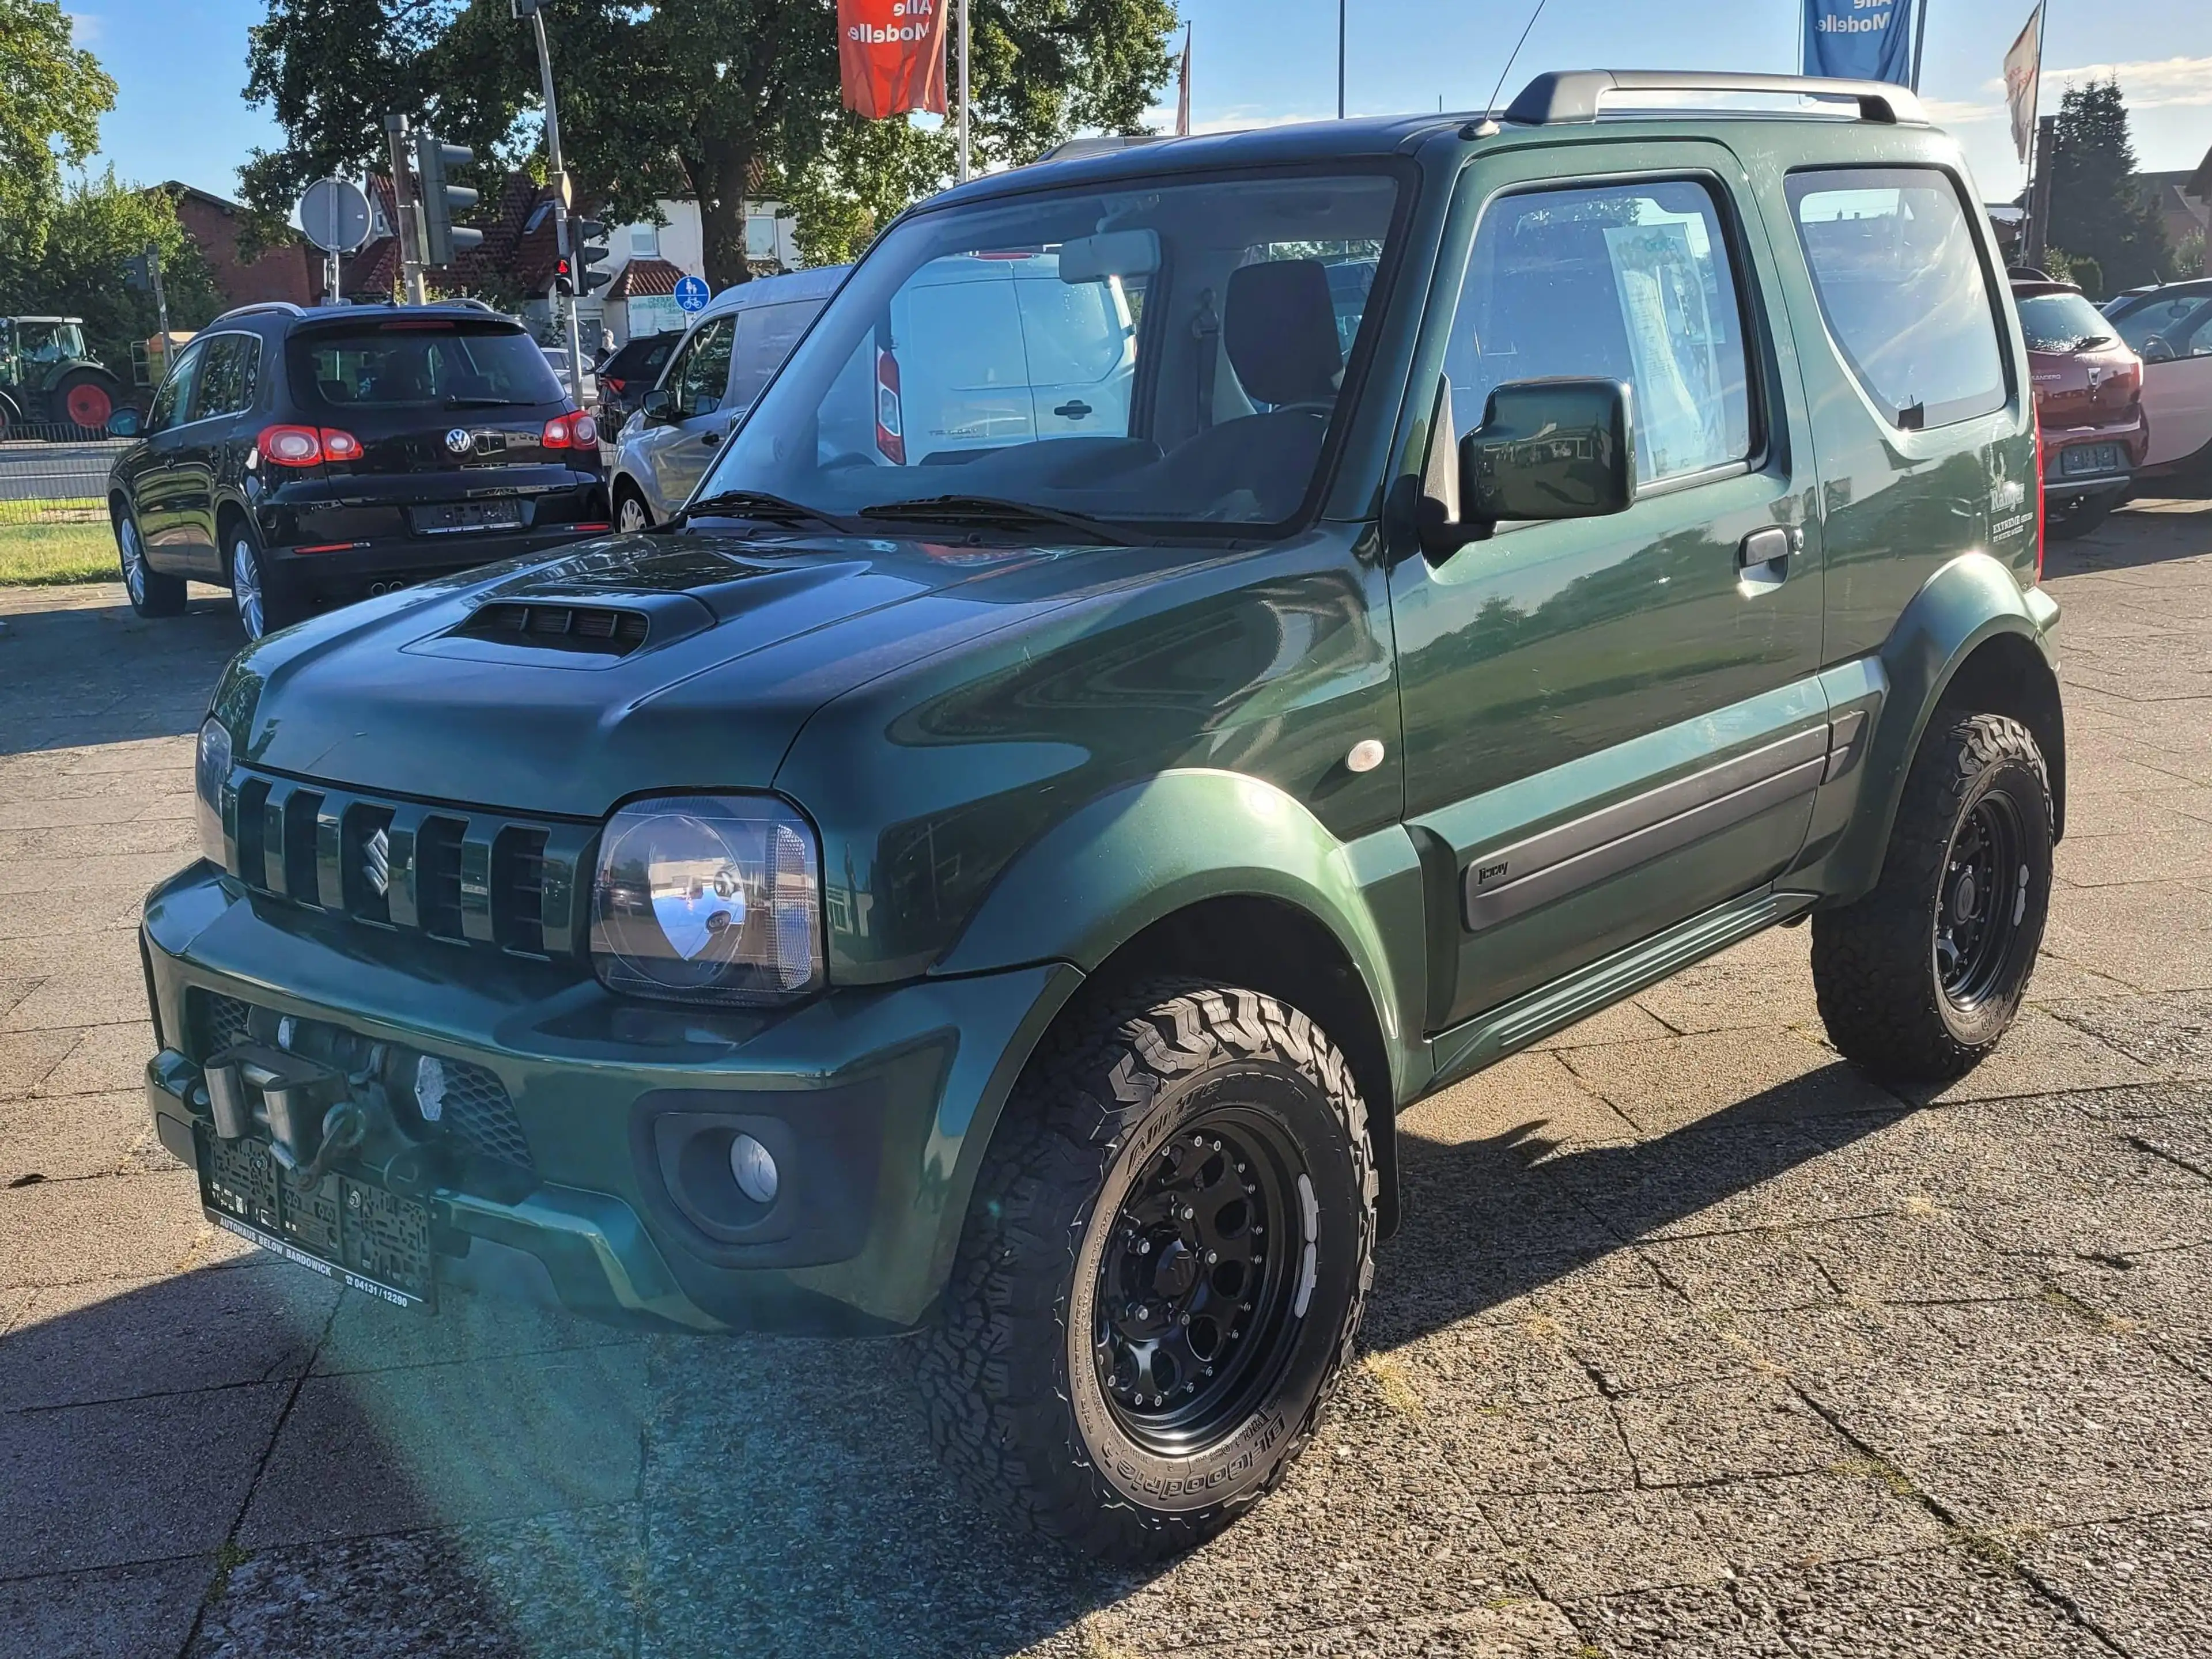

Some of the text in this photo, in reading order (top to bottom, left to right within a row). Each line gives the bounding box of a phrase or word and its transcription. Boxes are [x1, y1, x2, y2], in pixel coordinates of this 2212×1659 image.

[220, 1217, 256, 1242] AUTOHAUS
[259, 1236, 283, 1255] BELOW
[286, 1248, 332, 1277] BARDOWICK
